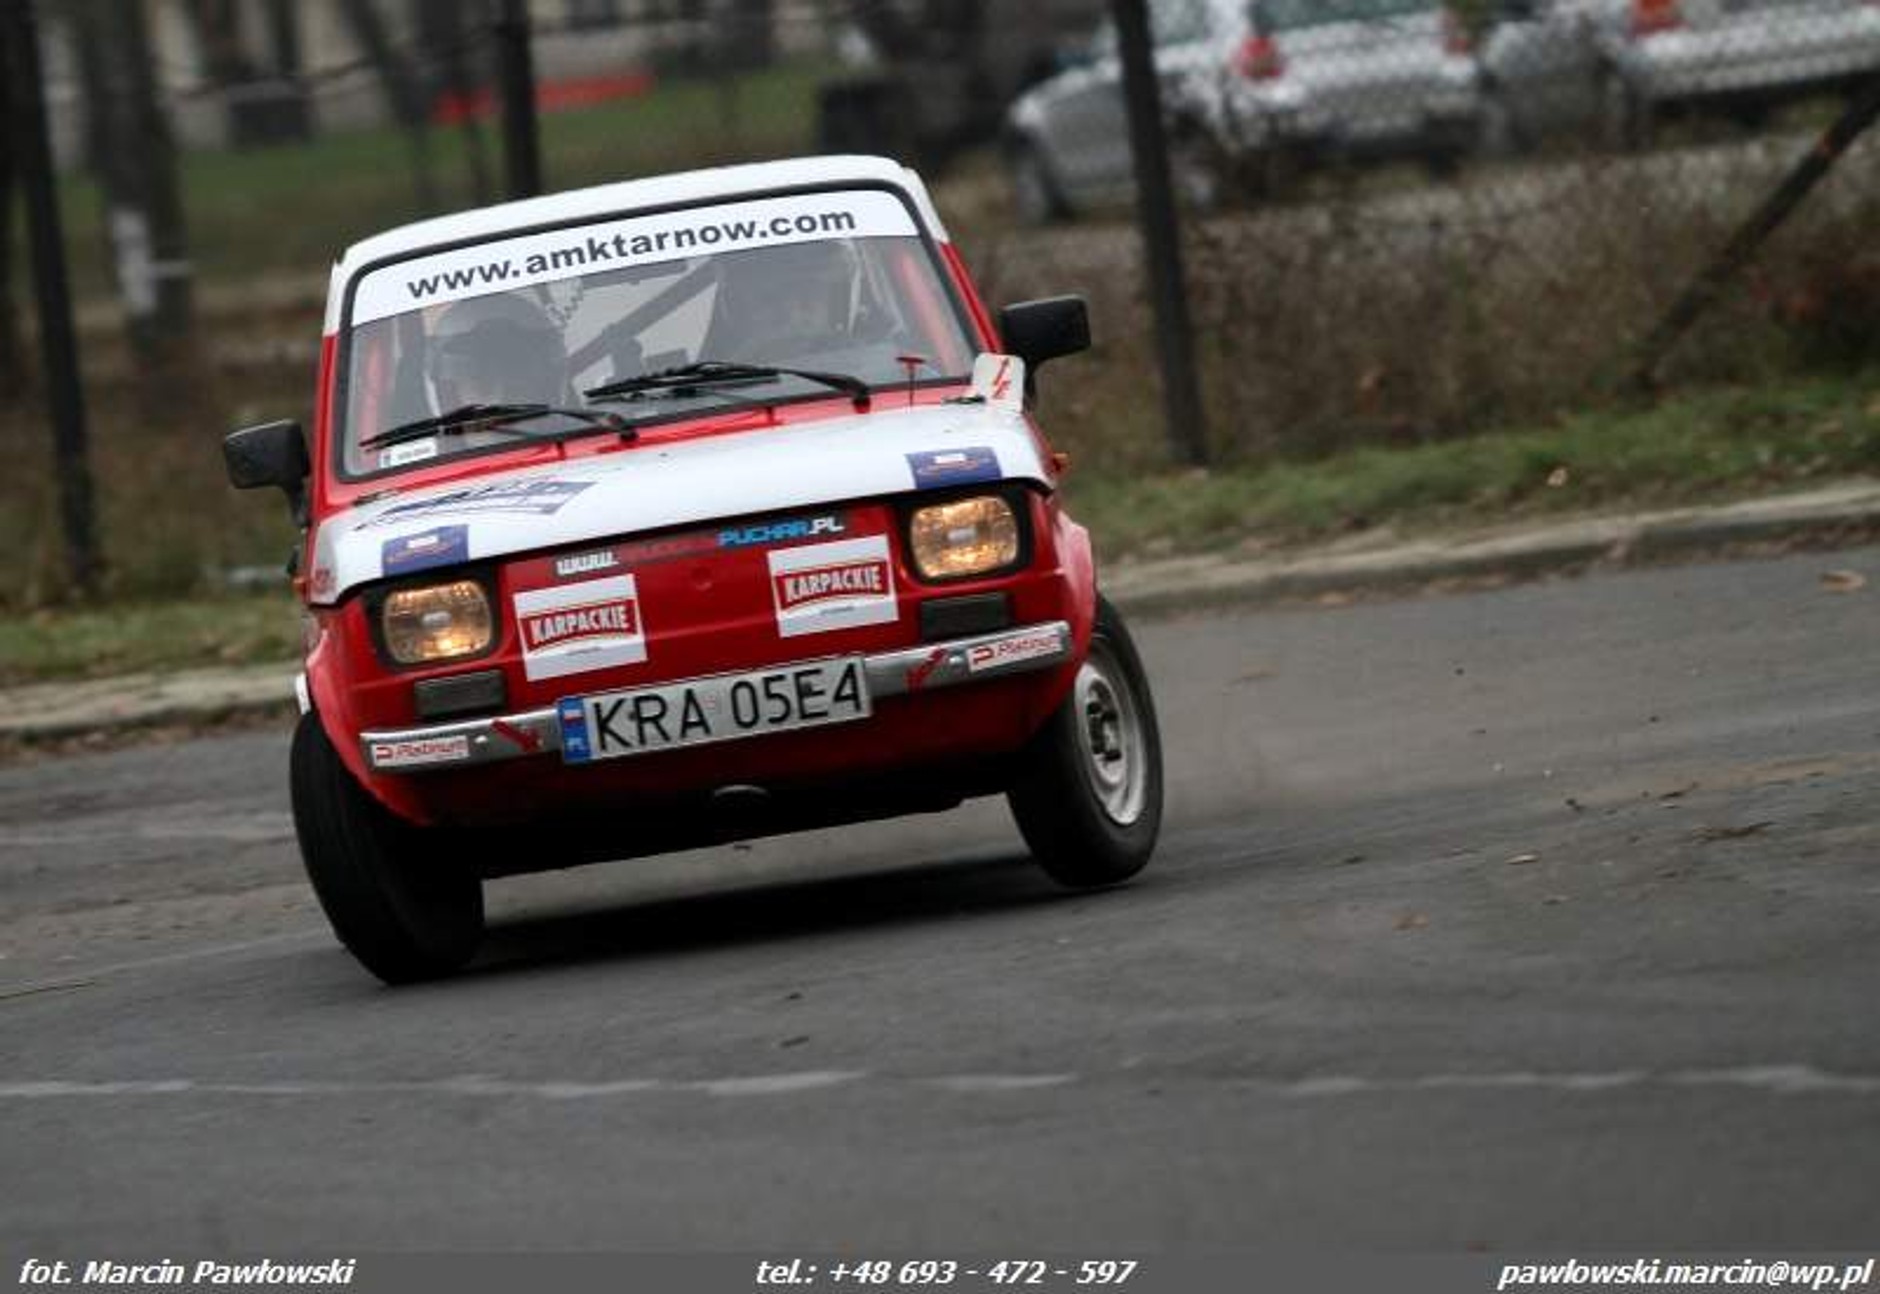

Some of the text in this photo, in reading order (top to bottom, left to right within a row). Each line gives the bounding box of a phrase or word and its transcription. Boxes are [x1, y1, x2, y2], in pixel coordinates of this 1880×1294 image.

[407, 211, 856, 299] www.amktarnow.com
[785, 565, 882, 602] KARPACKIE
[529, 605, 630, 644] KARPACKIE
[593, 662, 863, 750] KRA 05E4
